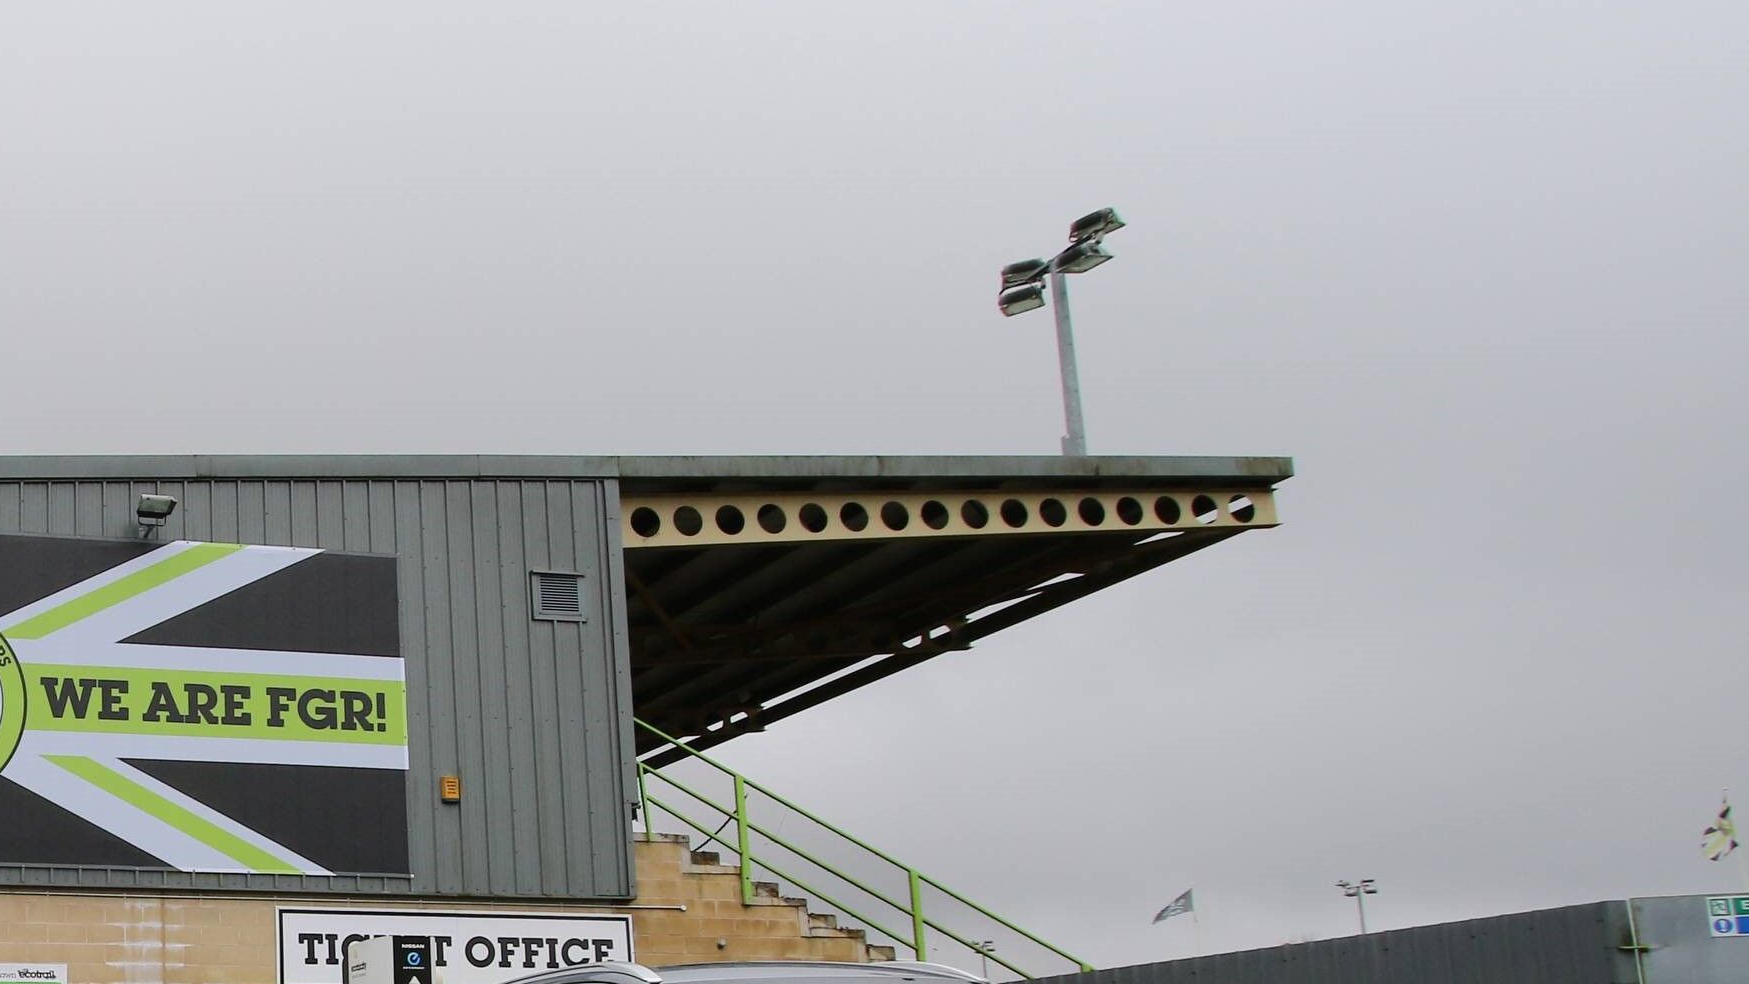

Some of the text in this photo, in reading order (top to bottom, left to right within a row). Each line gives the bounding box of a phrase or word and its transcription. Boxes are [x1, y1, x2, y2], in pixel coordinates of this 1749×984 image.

[40, 677, 387, 732] WE ARE FGR!
[465, 936, 615, 969] OFFICE
